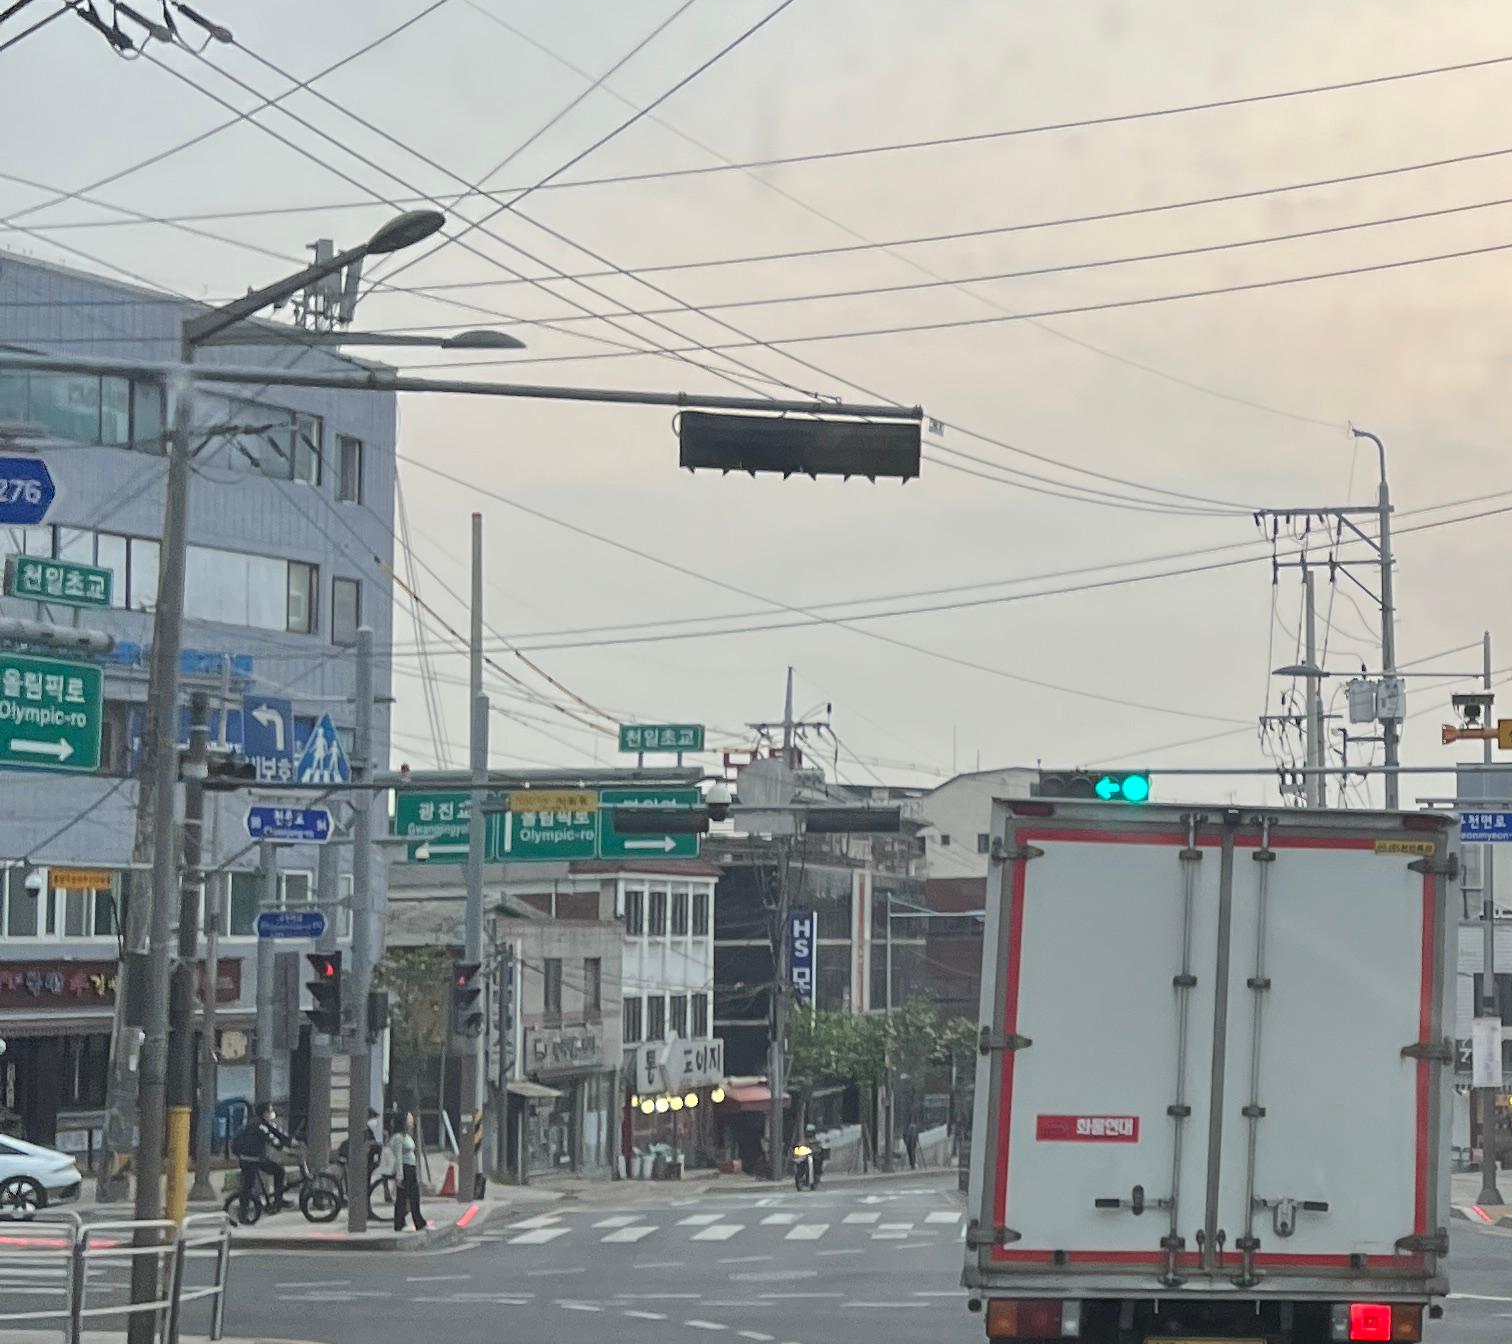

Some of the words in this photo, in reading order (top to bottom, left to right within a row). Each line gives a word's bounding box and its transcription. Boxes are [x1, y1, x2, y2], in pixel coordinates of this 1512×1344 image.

[0, 469, 42, 504] 276
[23, 564, 105, 600] 천일초교
[2, 668, 86, 703] 올림픽로
[0, 700, 87, 728] Olympic-ro
[625, 728, 695, 748] 천일초교
[519, 827, 595, 844] Olympic-ro
[792, 919, 811, 958] HS
[1076, 1118, 1134, 1136] 화물연대
